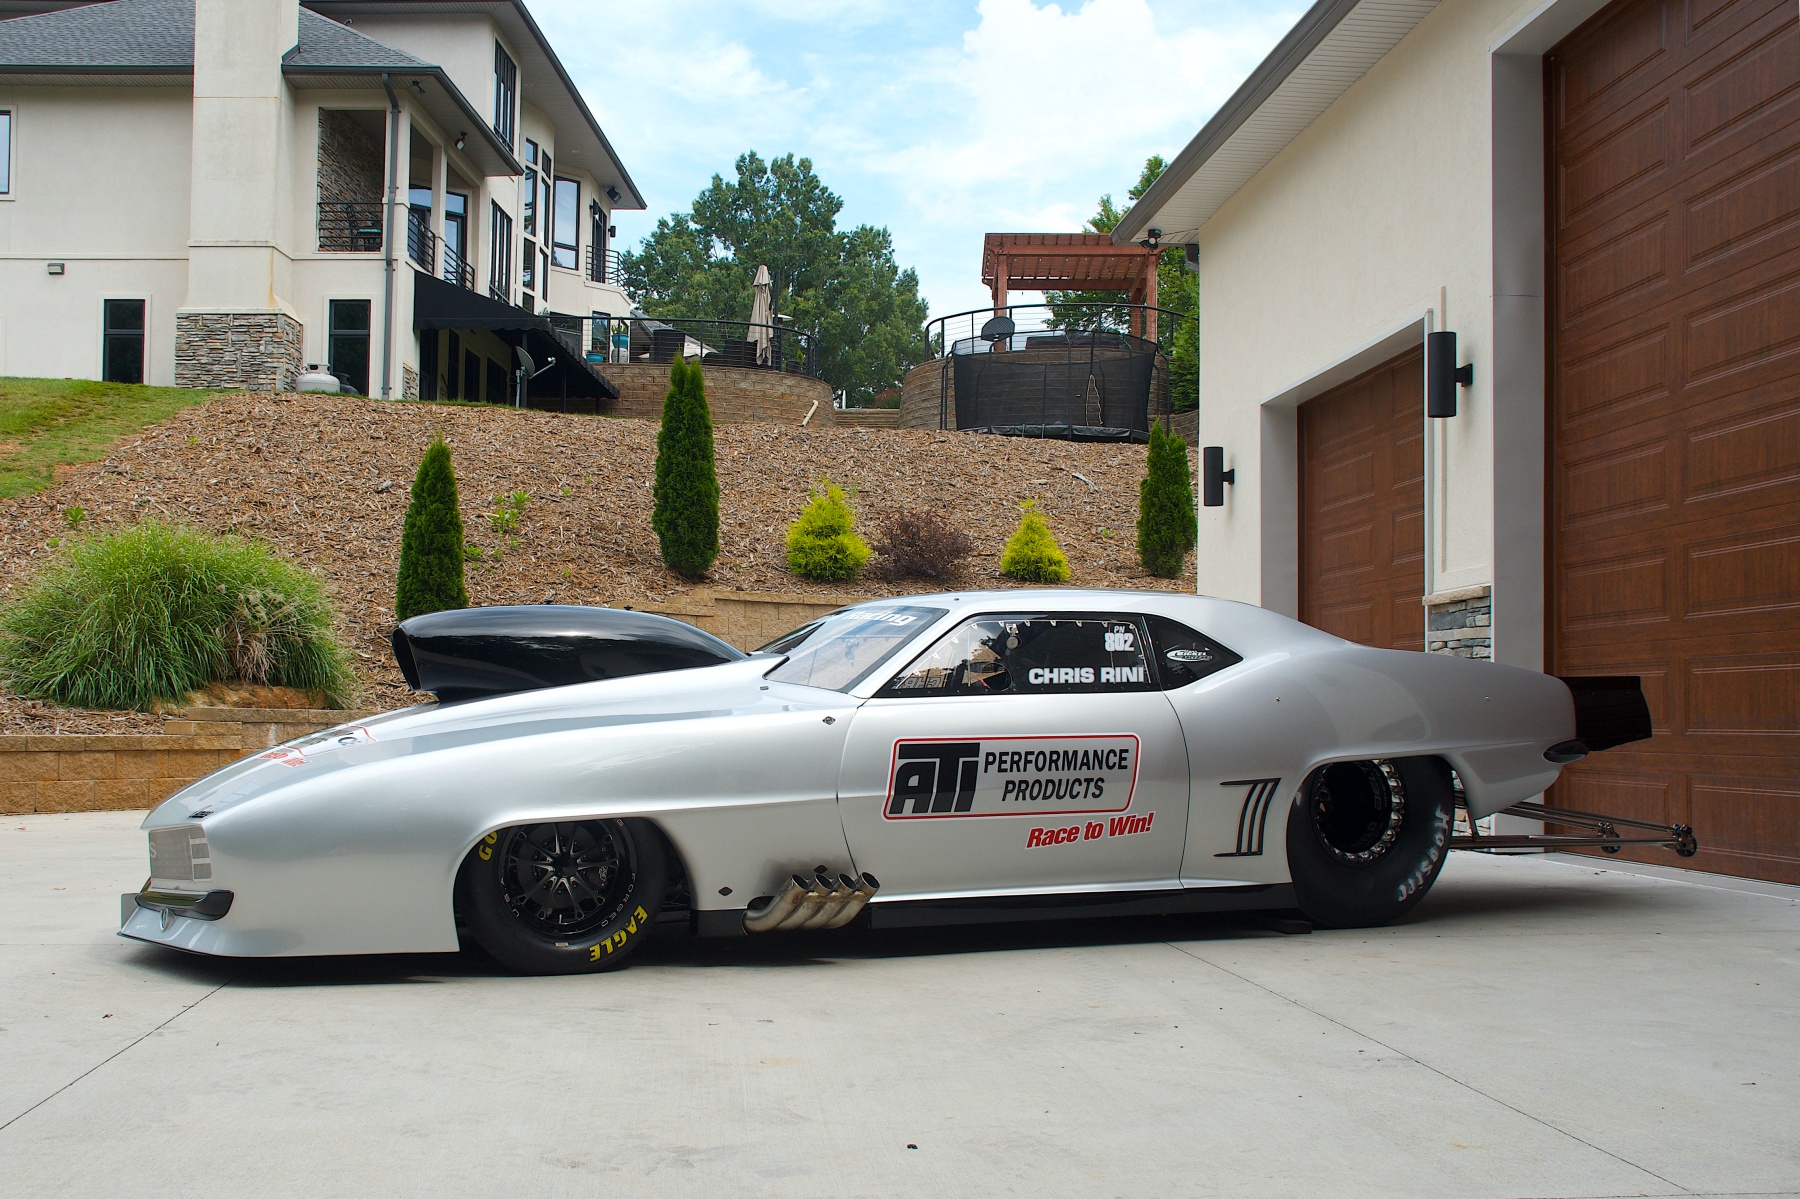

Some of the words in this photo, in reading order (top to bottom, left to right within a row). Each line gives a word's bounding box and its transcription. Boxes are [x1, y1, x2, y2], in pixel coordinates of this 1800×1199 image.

[1104, 632, 1135, 652] 802
[1028, 667, 1095, 685] CHRIS
[1100, 666, 1145, 684] RINI
[888, 742, 981, 815] ATI
[983, 748, 1130, 774] PERFORMANCE
[1001, 777, 1106, 802] PRODUCTS
[1026, 826, 1080, 849] Race
[1083, 819, 1105, 841] to
[1108, 811, 1155, 838] Win!
[589, 904, 648, 962] EAGLE
